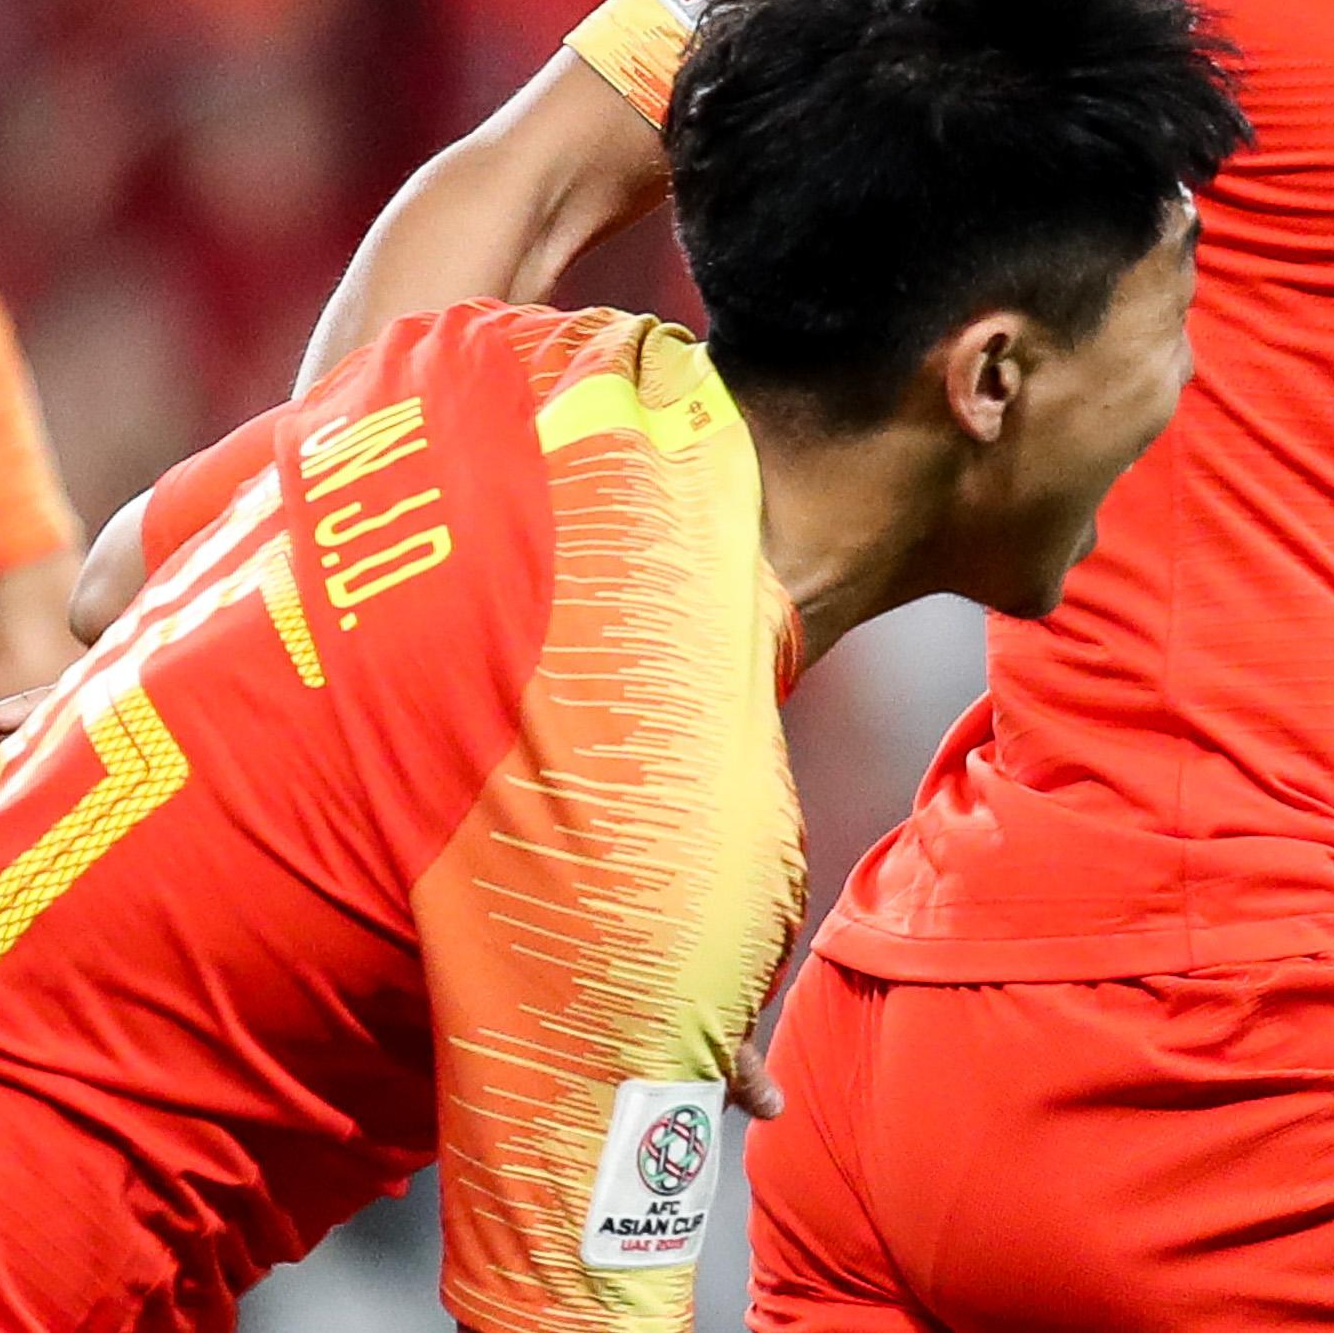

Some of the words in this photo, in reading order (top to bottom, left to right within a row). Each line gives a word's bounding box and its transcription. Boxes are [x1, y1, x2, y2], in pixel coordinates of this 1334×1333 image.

[299, 396, 428, 503] JIN
[314, 487, 453, 632] J.D.
[599, 1216, 669, 1236] ASIAN
[647, 1200, 680, 1216] AFC
